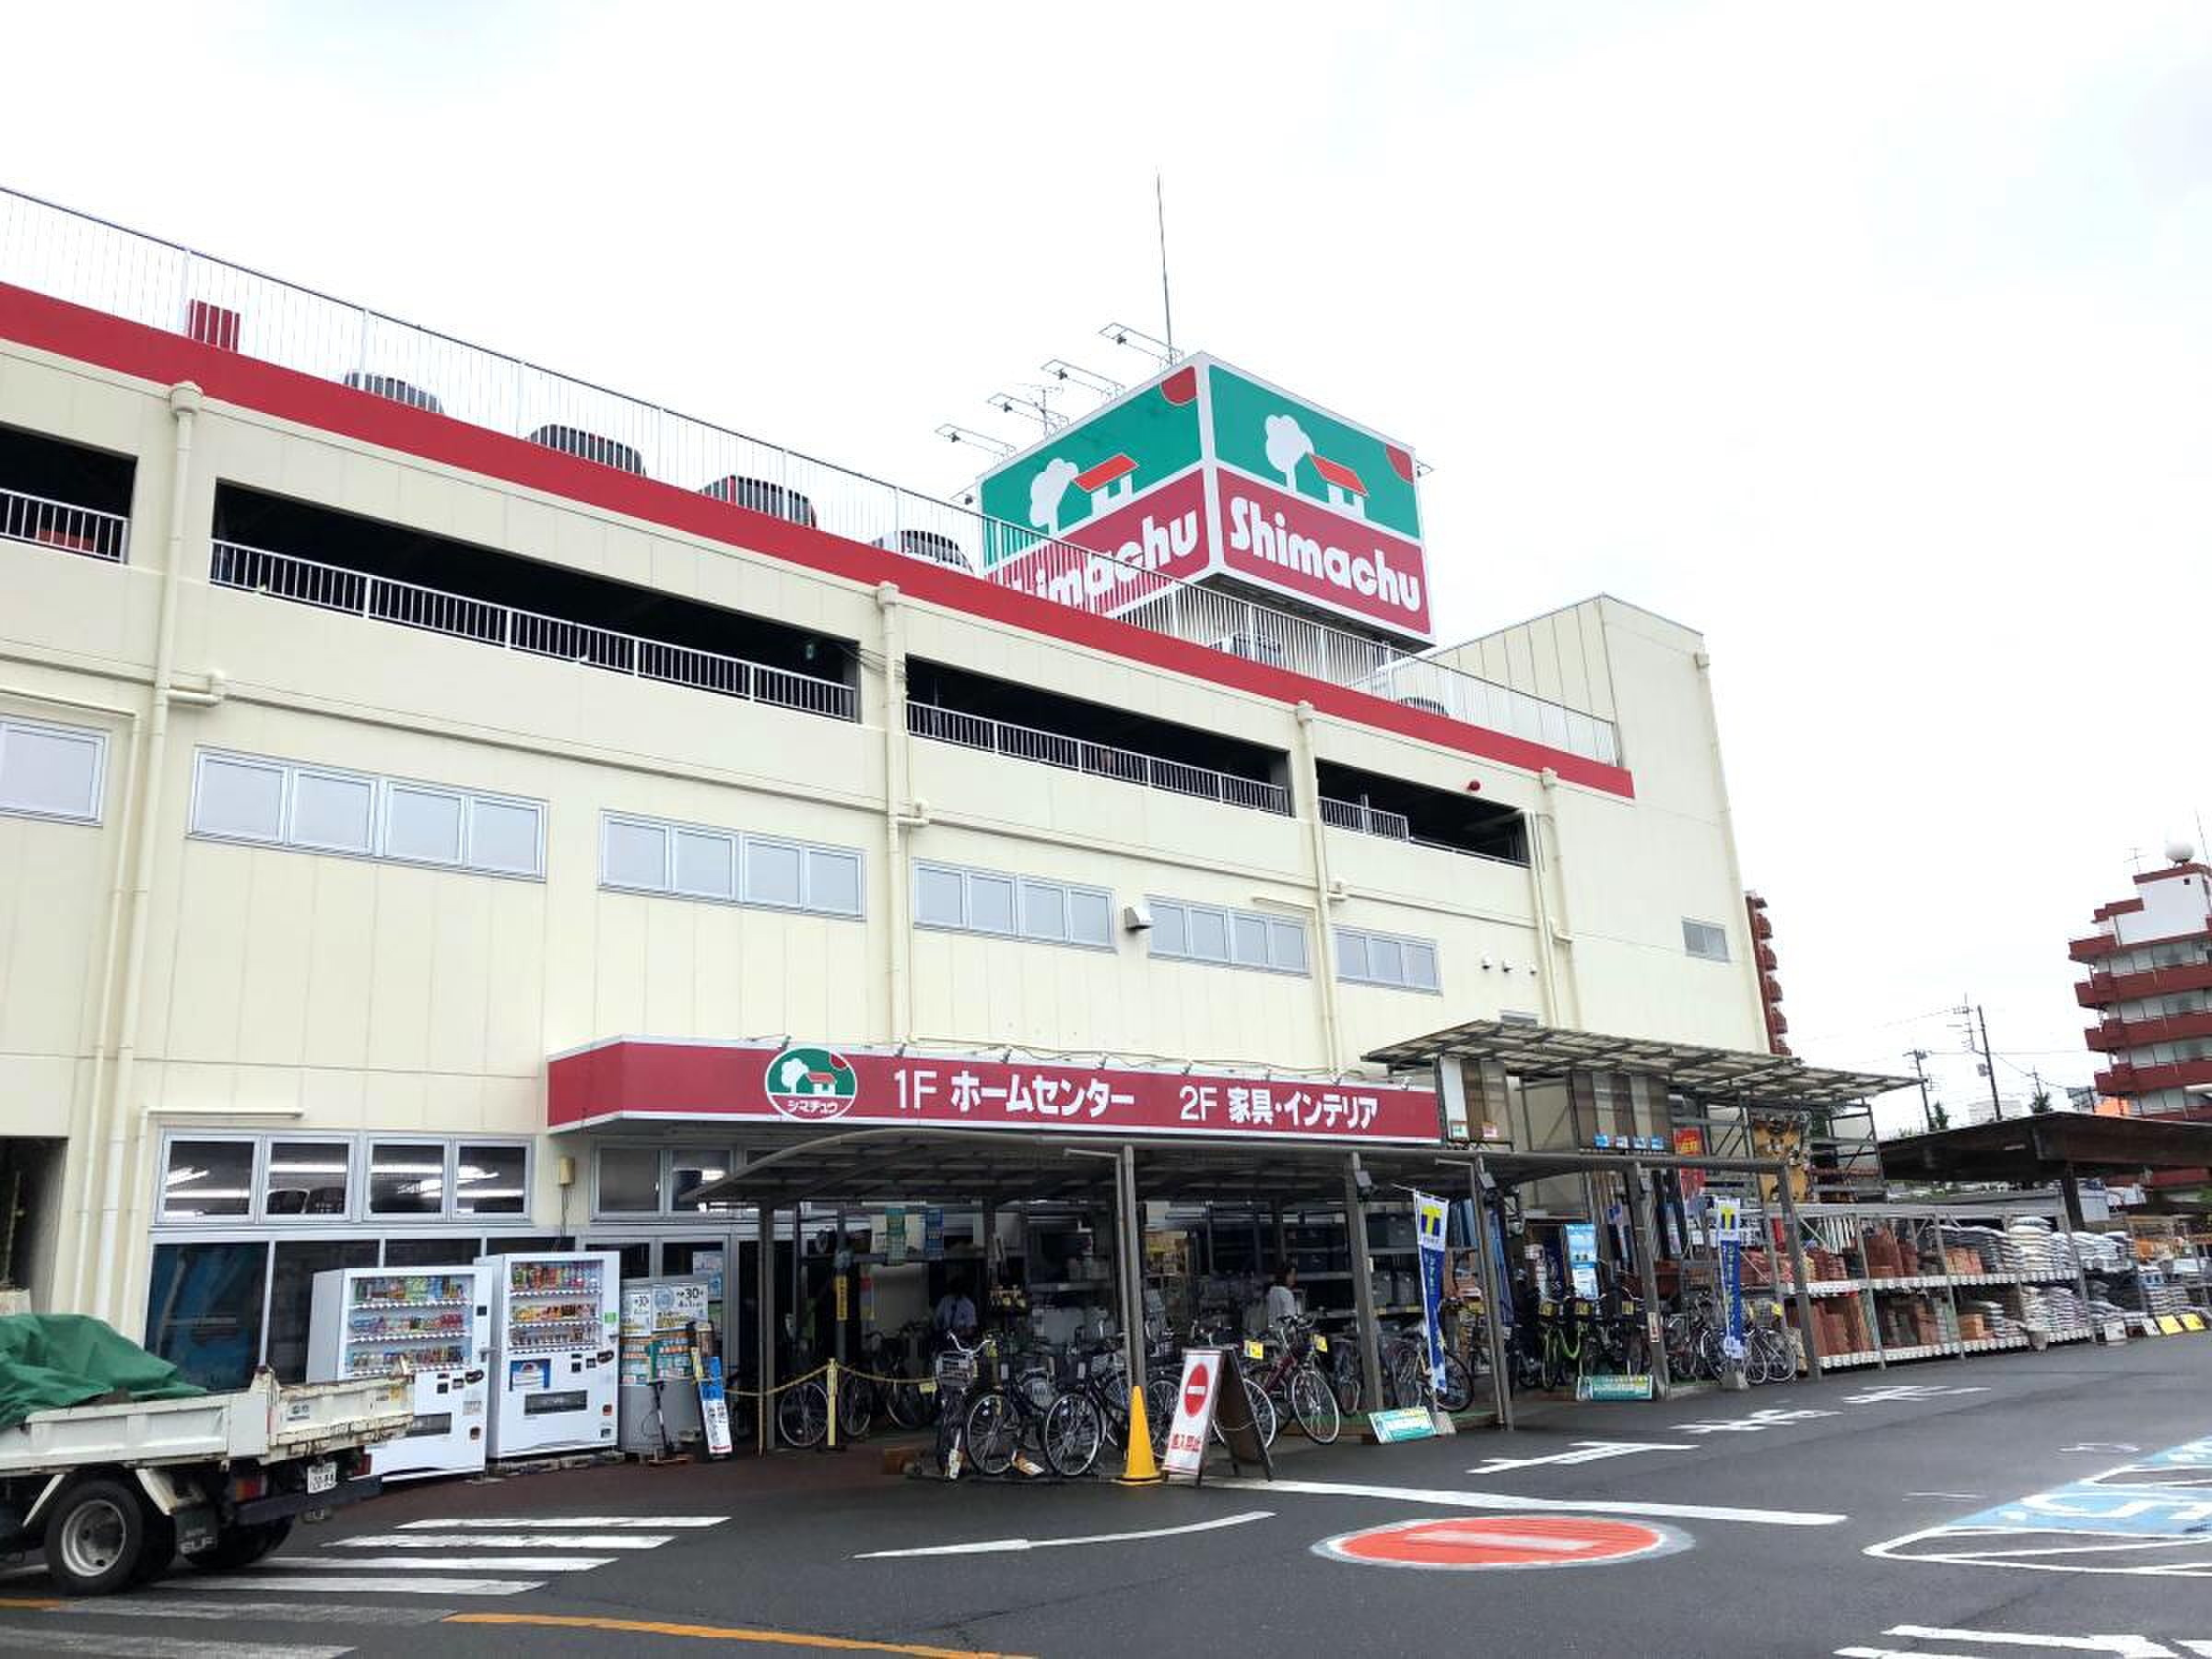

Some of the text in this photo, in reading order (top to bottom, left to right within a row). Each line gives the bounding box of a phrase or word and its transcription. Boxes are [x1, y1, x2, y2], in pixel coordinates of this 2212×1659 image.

[1230, 496, 1421, 613] Shimachu
[786, 1099, 840, 1115] シマチュウ
[894, 1069, 1135, 1119] 1F ホームセンター
[1179, 1085, 1378, 1130] 2F 家具・インテリア
